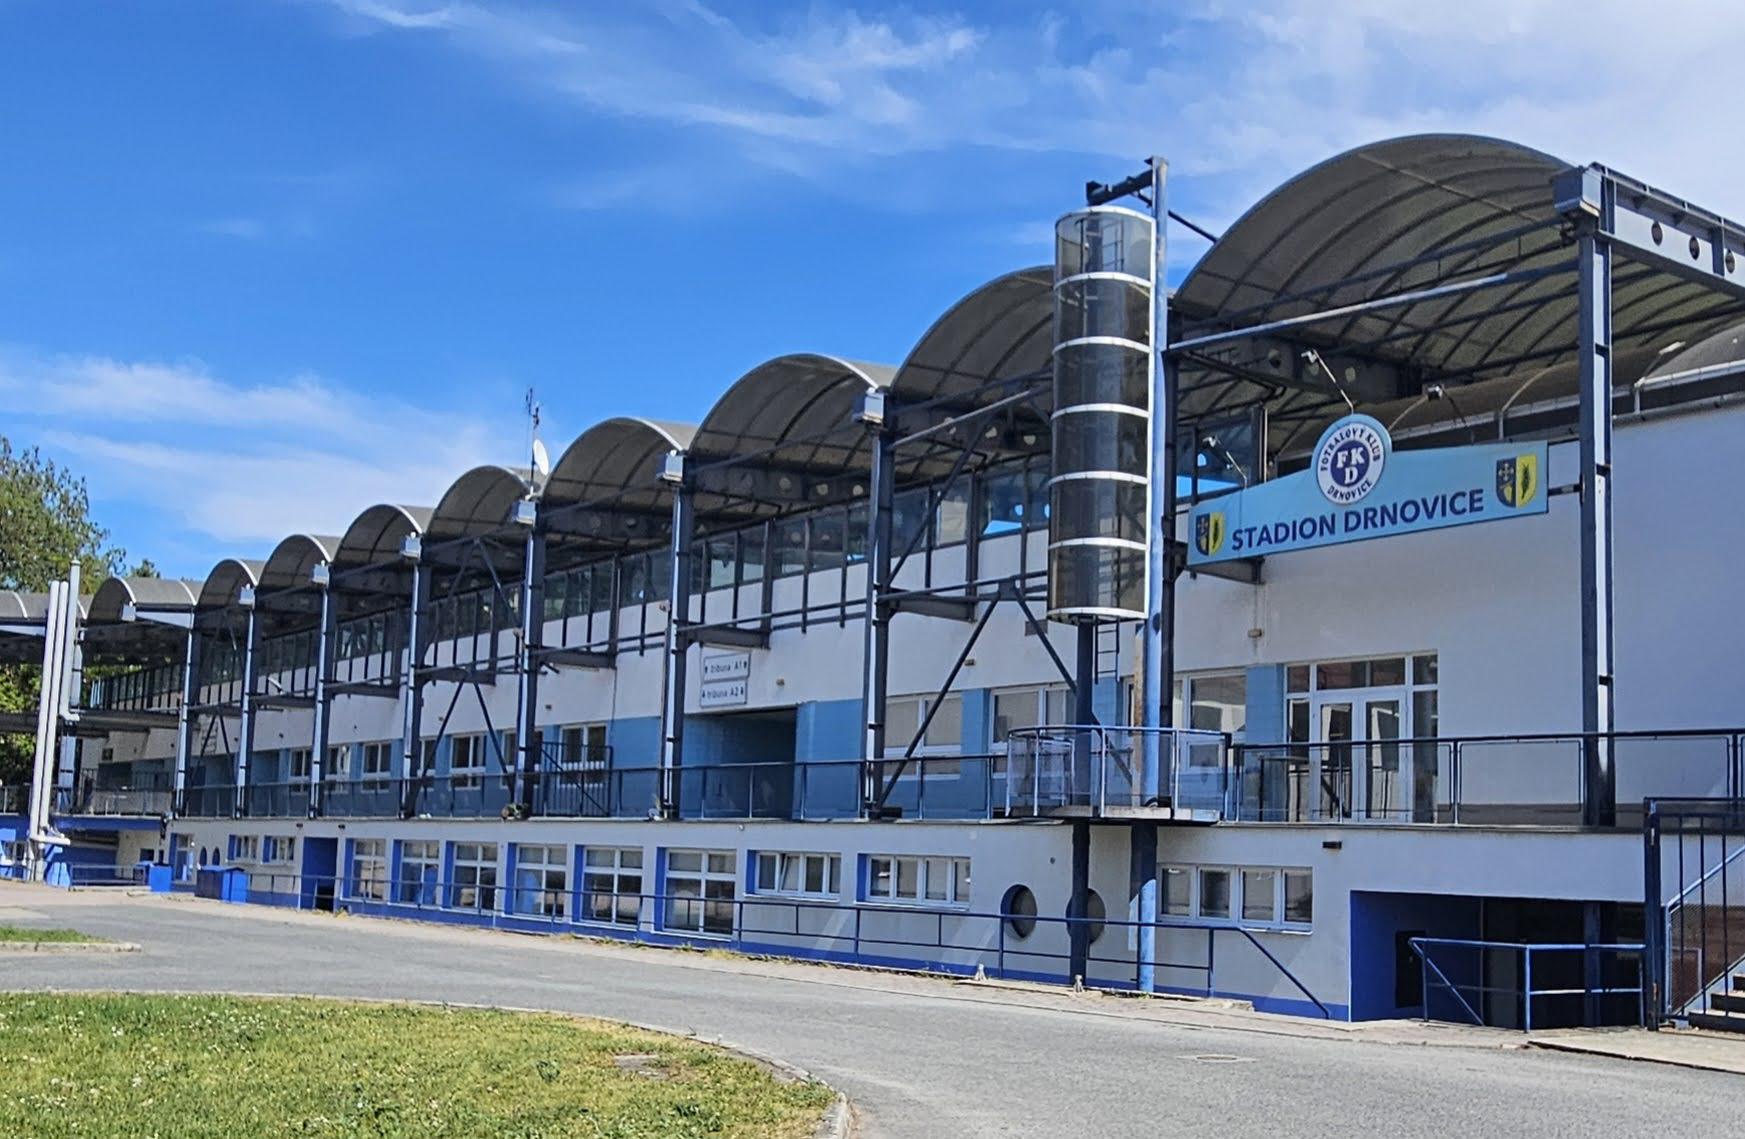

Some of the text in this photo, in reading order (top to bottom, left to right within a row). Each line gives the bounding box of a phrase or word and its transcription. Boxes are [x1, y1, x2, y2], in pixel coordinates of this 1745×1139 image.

[1366, 432, 1382, 462] KLUB
[1327, 478, 1373, 501] DRNOVICE
[1232, 488, 1485, 551] STADION DRNOVICE
